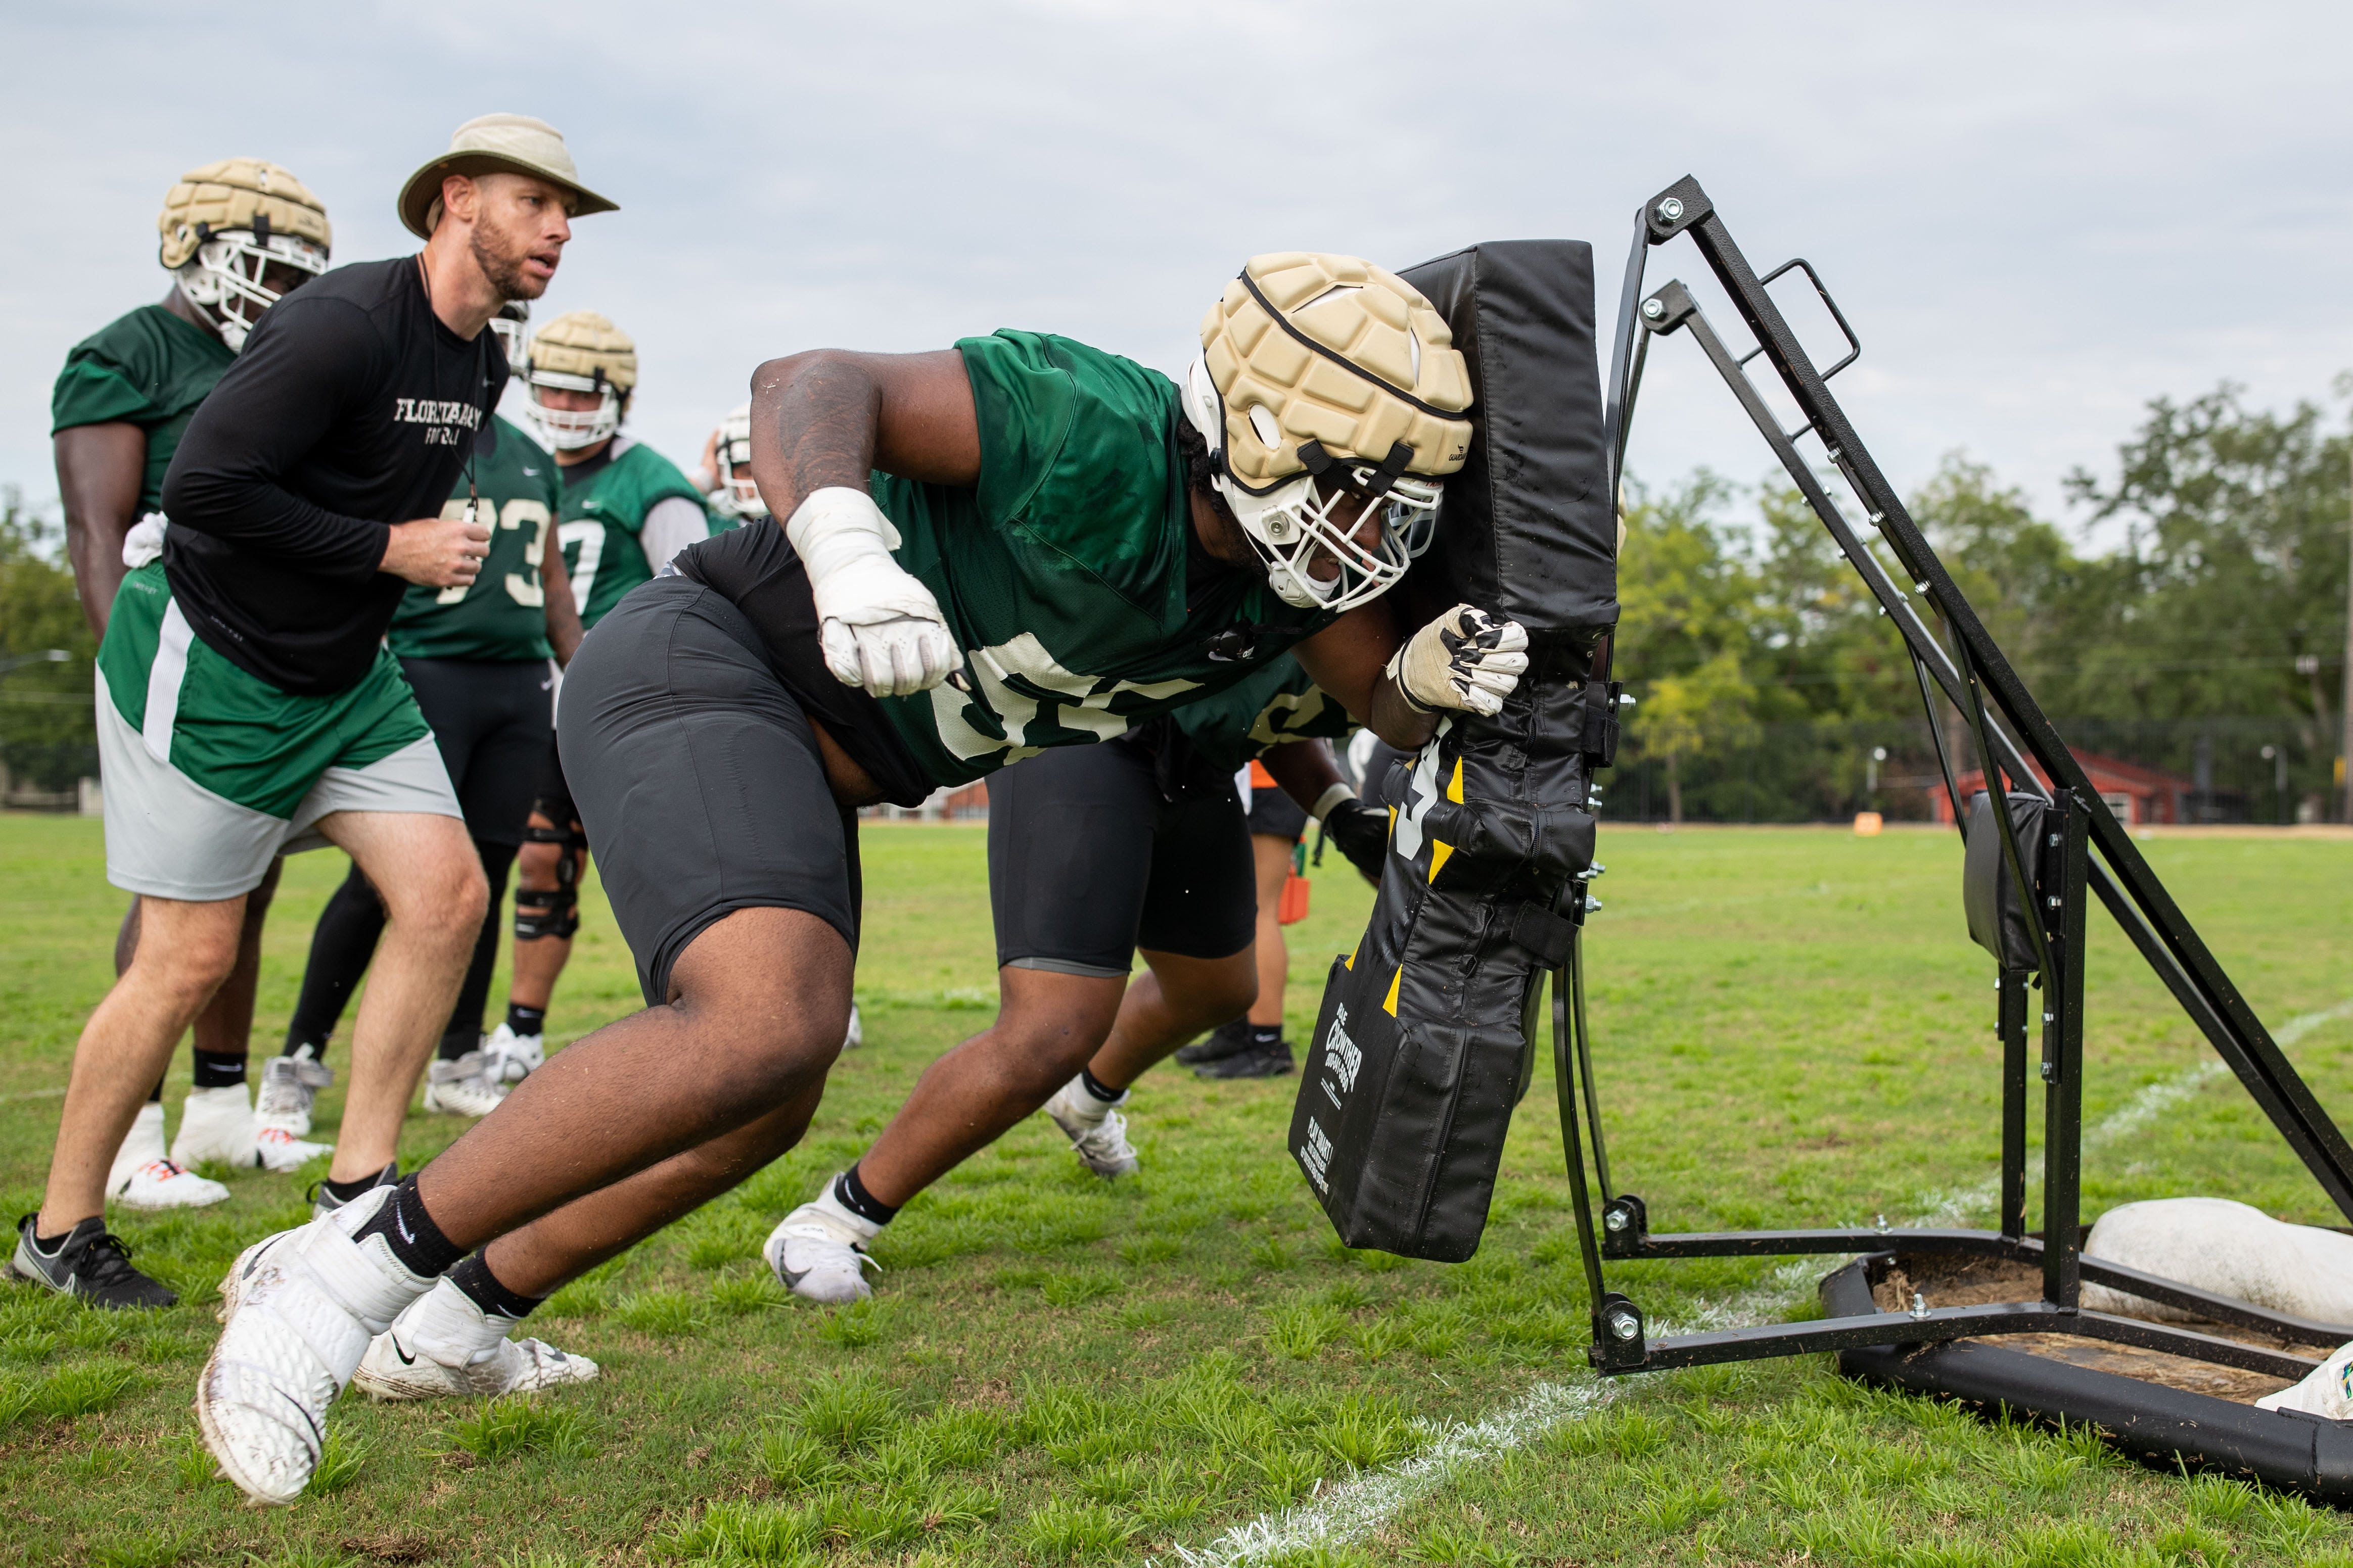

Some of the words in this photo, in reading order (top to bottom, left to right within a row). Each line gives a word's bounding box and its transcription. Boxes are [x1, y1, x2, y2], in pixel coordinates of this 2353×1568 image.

[1336, 1002, 1348, 1026] RAE
[1326, 1019, 1362, 1093] CROWTHER
[1307, 1116, 1320, 1144] PLAY
